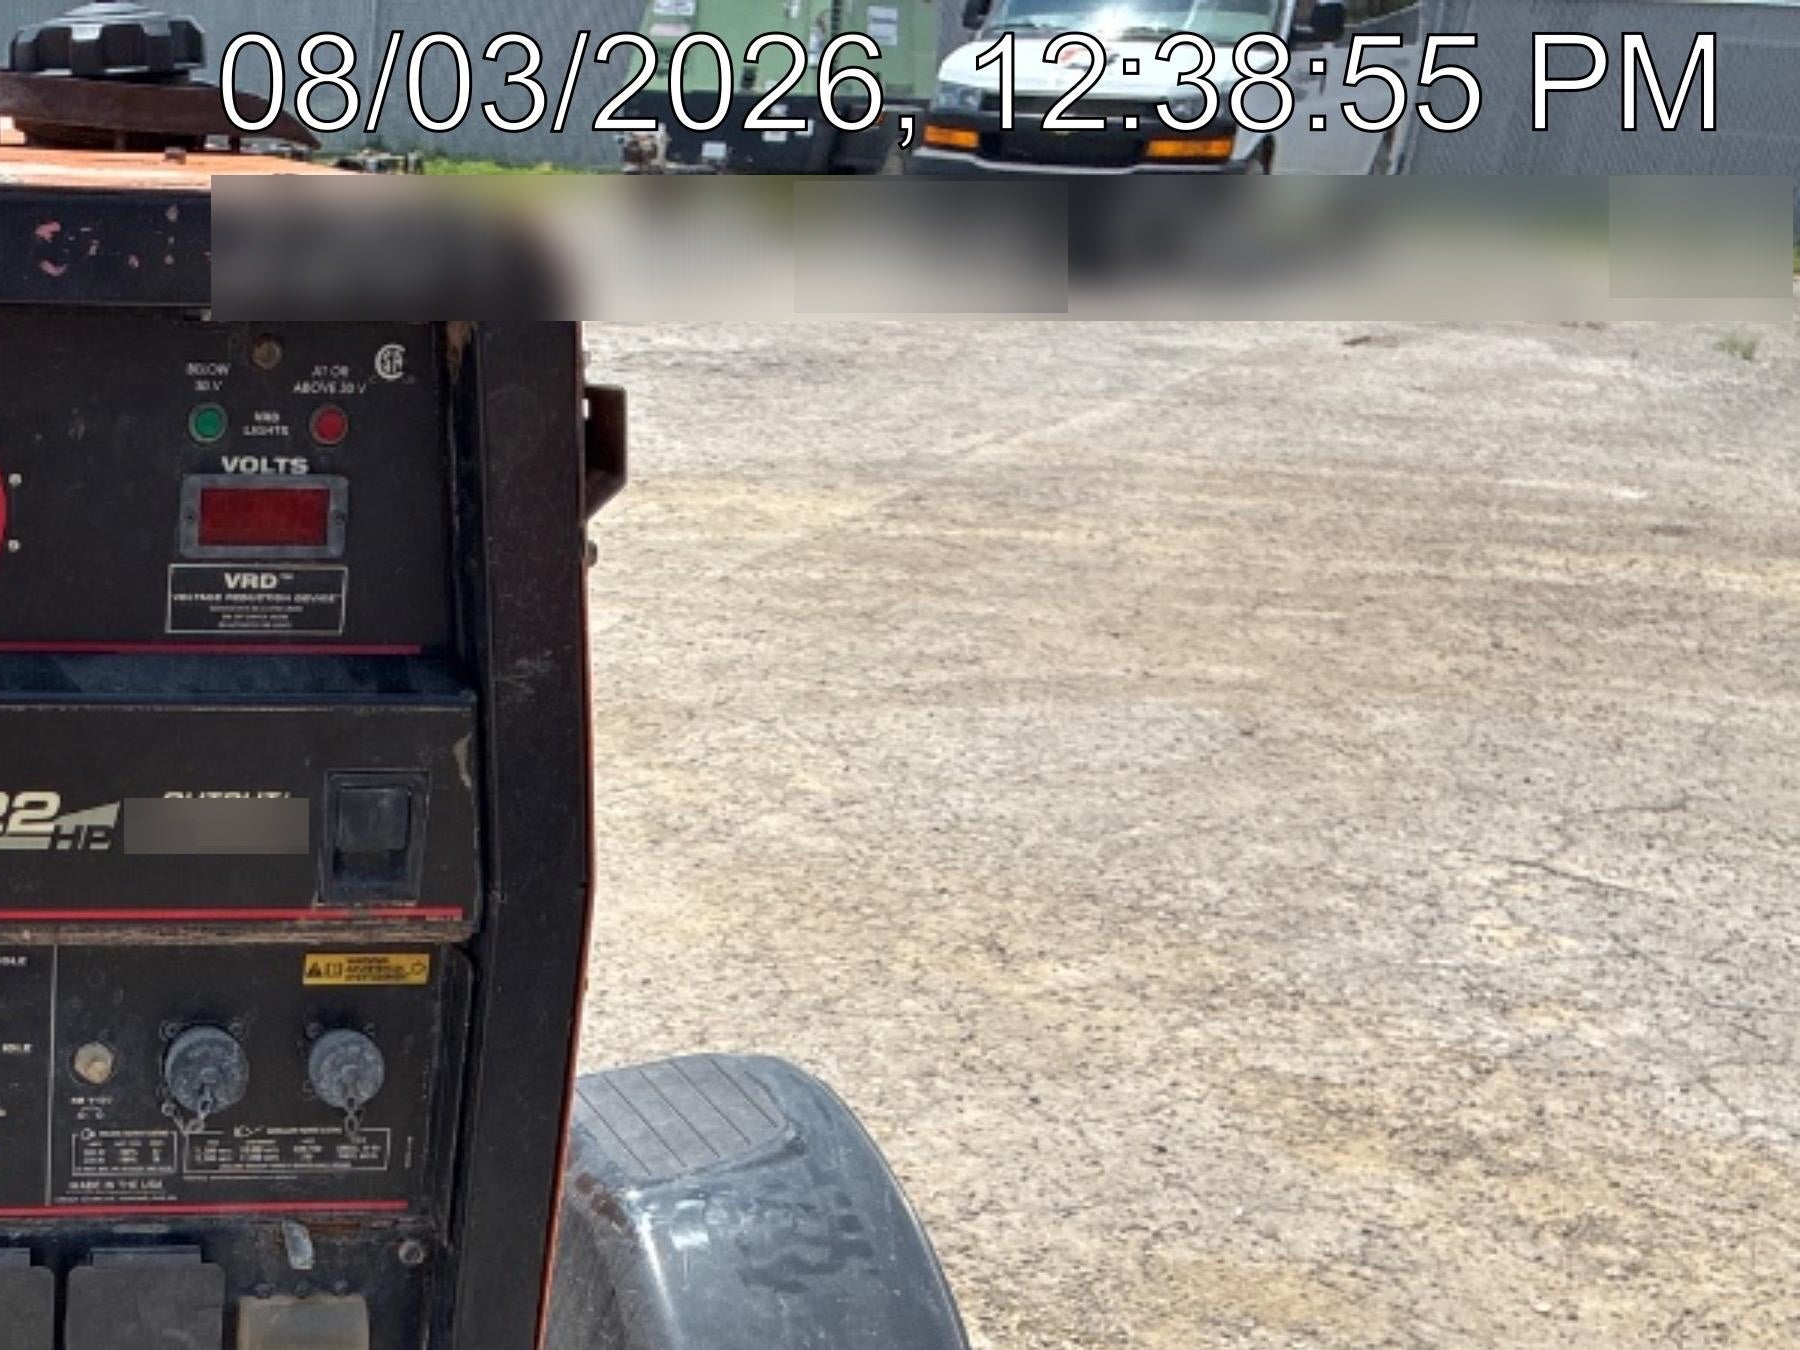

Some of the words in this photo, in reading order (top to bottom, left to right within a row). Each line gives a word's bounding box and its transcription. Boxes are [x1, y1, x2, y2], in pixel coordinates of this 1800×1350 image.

[185, 362, 232, 376] BELOW
[292, 380, 336, 394] ABOVE
[243, 425, 290, 436] LIGHTS
[221, 455, 310, 474] VOLTS
[8, 473, 22, 487] 8
[7, 539, 21, 553] 9
